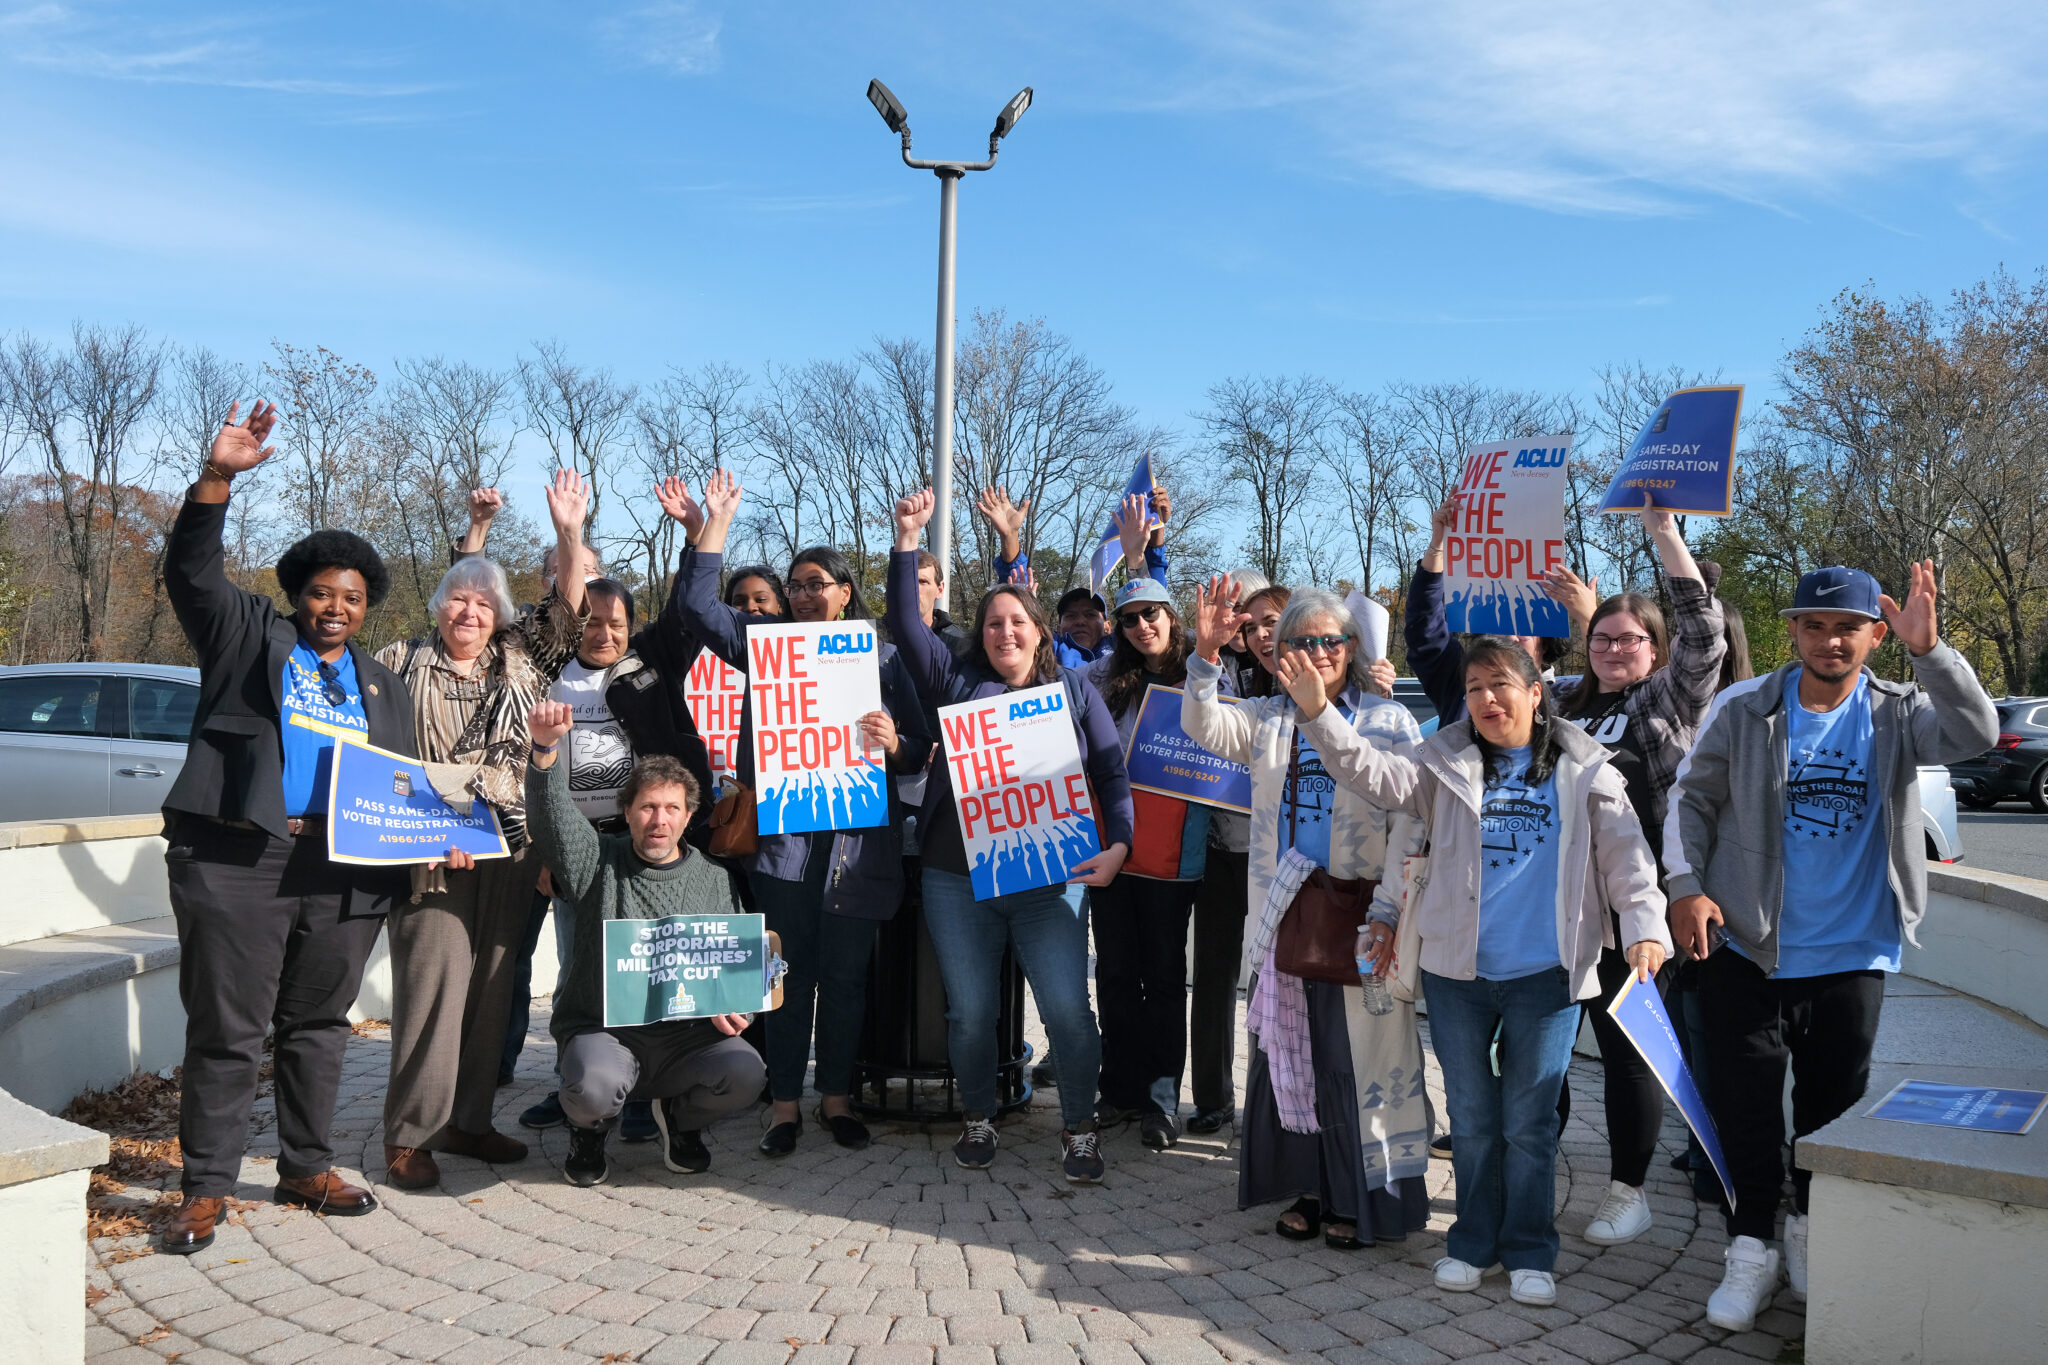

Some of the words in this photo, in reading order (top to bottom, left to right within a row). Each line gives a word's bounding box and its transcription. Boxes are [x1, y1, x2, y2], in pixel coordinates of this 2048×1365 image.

[1513, 447, 1566, 468] ACLU
[1639, 444, 1701, 457] SAME-DAY
[1461, 450, 1509, 490] WE
[1527, 470, 1550, 479] Jersey
[1631, 460, 1719, 472] REGISTRATION
[1452, 492, 1506, 534] THE
[1447, 536, 1563, 580] PEOPLE
[817, 632, 873, 655] ACLU
[751, 636, 807, 680] WE
[817, 657, 834, 665] New
[836, 656, 861, 664] Jersey
[690, 654, 736, 691] WE
[687, 694, 744, 731] THE
[752, 681, 820, 726] THE
[1008, 693, 1063, 721] ACLU
[943, 707, 1002, 752] WE
[1010, 719, 1027, 730] New
[1029, 715, 1053, 727] Jersey
[758, 725, 883, 772] PEOPLE
[1153, 733, 1181, 747] PASS
[949, 744, 1020, 793] THE
[1139, 742, 1172, 758] VOTER
[1174, 750, 1250, 775] REGISTRATIO
[1163, 764, 1221, 784] A1966/S247
[1810, 782, 1833, 790] THE
[355, 797, 386, 813] PASS
[960, 773, 1090, 839] PEOPLE
[1489, 802, 1512, 812] THE
[1513, 804, 1546, 815] ROAD
[342, 808, 381, 826] VOTER
[385, 817, 485, 830] REGISTRATION
[378, 834, 447, 844] A1966/S247
[640, 922, 686, 941] STOP
[690, 921, 728, 935] THE
[630, 936, 739, 956] CORPORATE
[617, 949, 752, 972] MILLIONAIRES'
[648, 968, 678, 986] TAX
[683, 966, 722, 980] CUT
